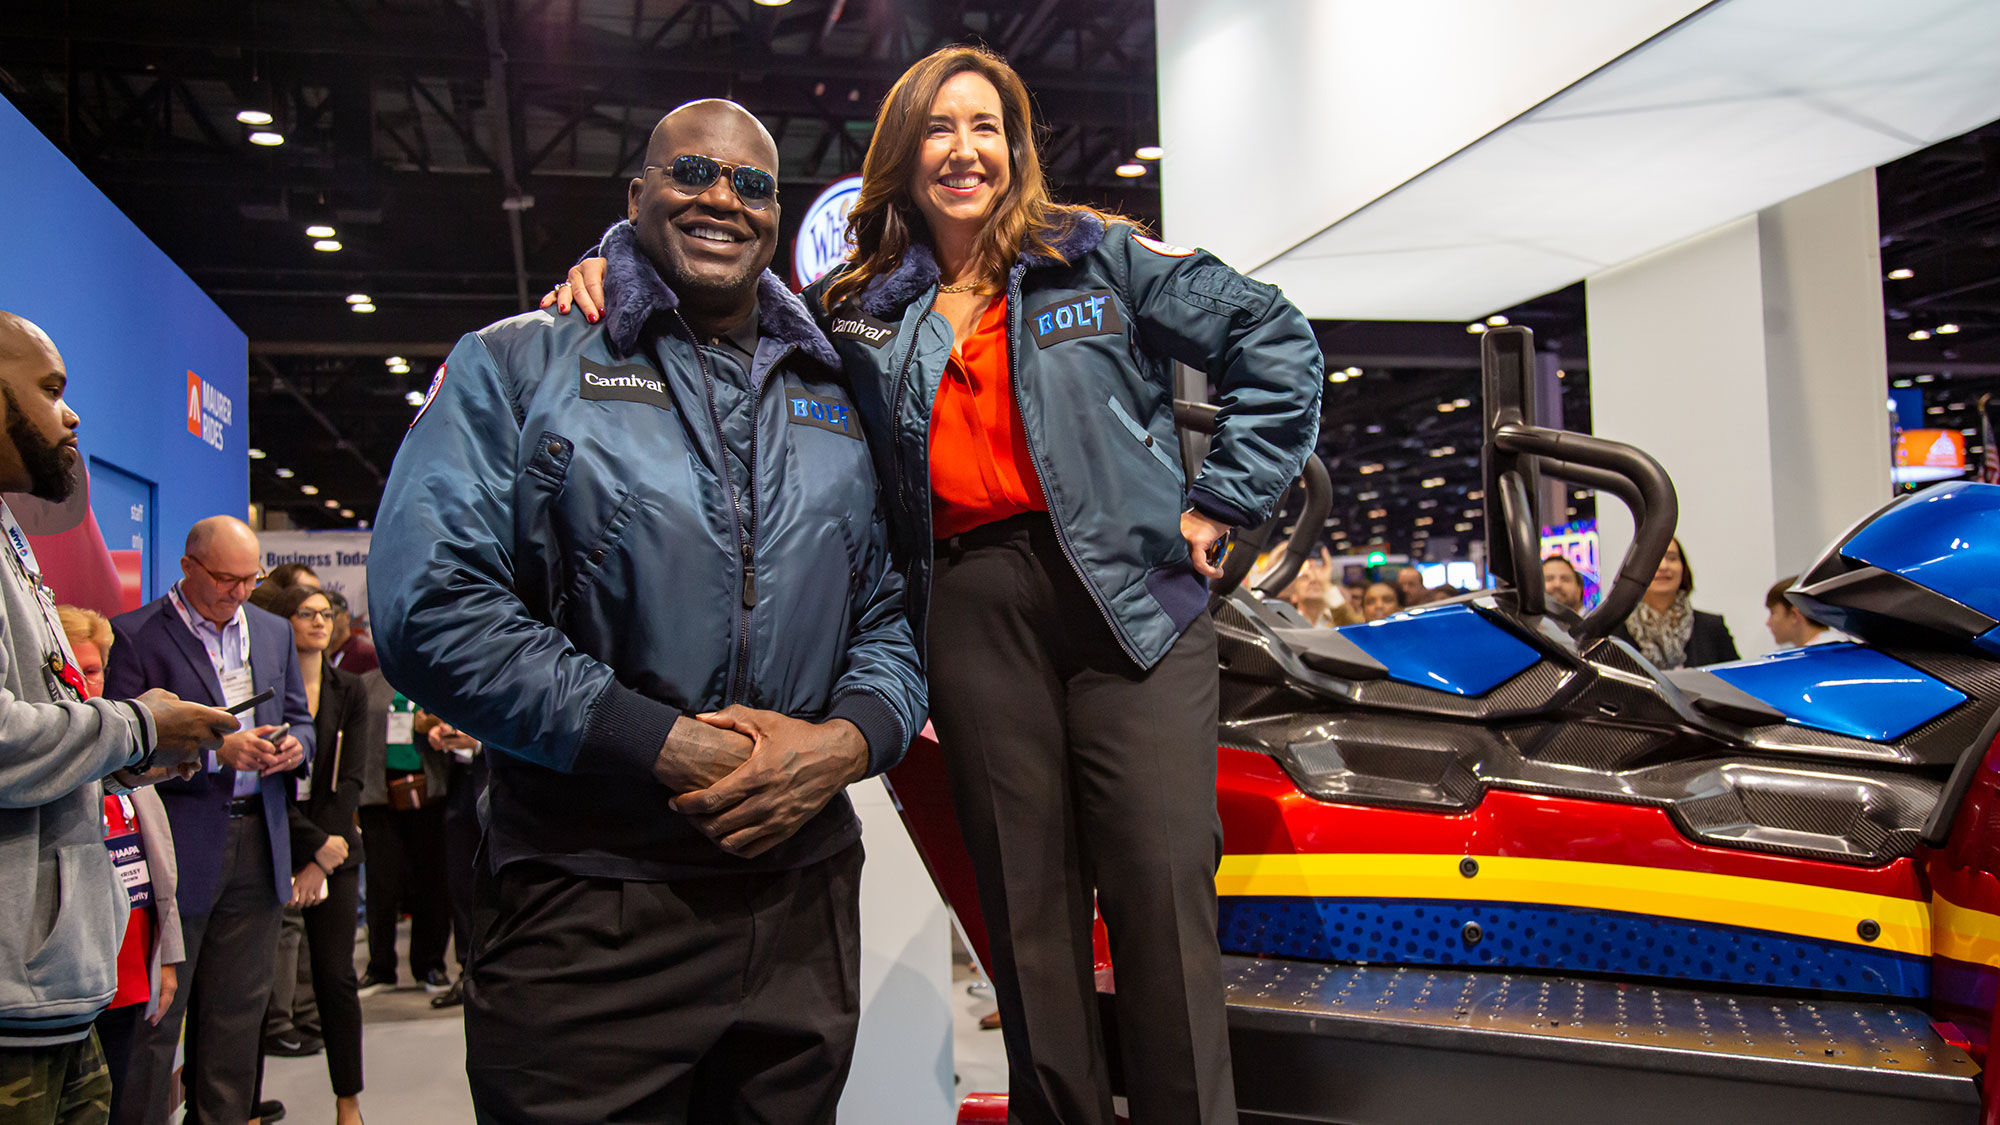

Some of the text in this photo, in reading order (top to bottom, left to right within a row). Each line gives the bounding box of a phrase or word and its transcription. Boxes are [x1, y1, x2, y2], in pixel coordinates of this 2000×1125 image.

[832, 317, 887, 342] Carnival
[1034, 295, 1110, 336] BOLT
[584, 372, 663, 393] Carnival
[203, 380, 232, 427] MAURER
[789, 398, 855, 433] BOLT
[203, 411, 224, 452] RIDES
[267, 551, 368, 568] Business Toda
[115, 845, 140, 858] IAAPA
